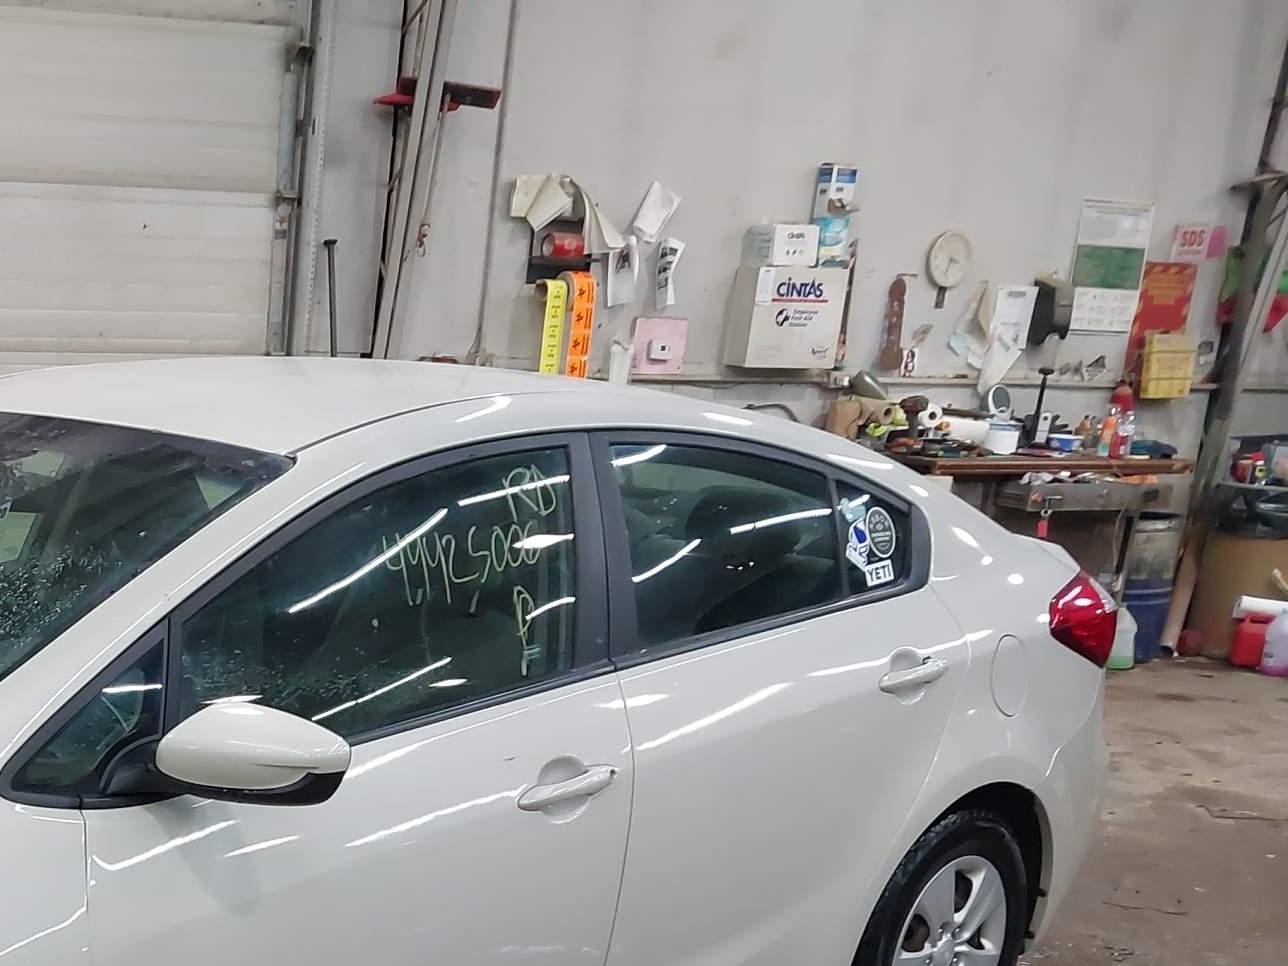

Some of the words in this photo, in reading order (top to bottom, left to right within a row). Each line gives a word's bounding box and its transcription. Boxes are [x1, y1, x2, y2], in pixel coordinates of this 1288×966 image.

[1180, 229, 1206, 248] SDS
[776, 276, 824, 299] CINTAS
[867, 564, 893, 582] YETI
